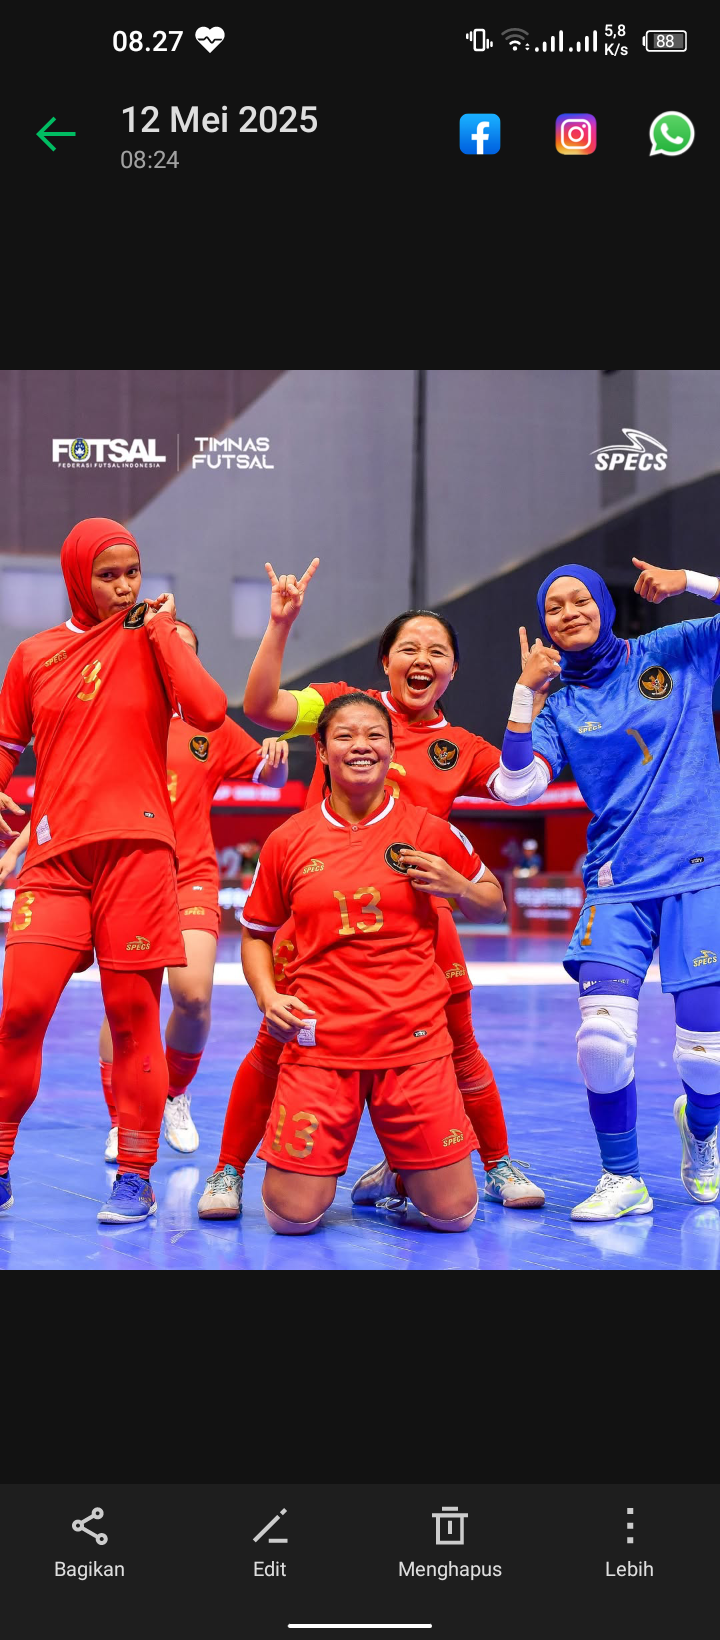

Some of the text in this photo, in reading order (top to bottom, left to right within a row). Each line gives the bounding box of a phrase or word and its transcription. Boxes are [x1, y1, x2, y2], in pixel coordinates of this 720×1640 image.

[44, 651, 68, 668] SPECS
[625, 728, 654, 766] 1
[302, 863, 325, 875] SPECS
[333, 886, 384, 936] 13
[580, 905, 597, 947] 1
[125, 942, 151, 952] SPECS
[692, 955, 718, 968] SPECS
[445, 968, 466, 980] SPECS
[271, 1104, 319, 1159] 13
[442, 1133, 465, 1148] SPECS
